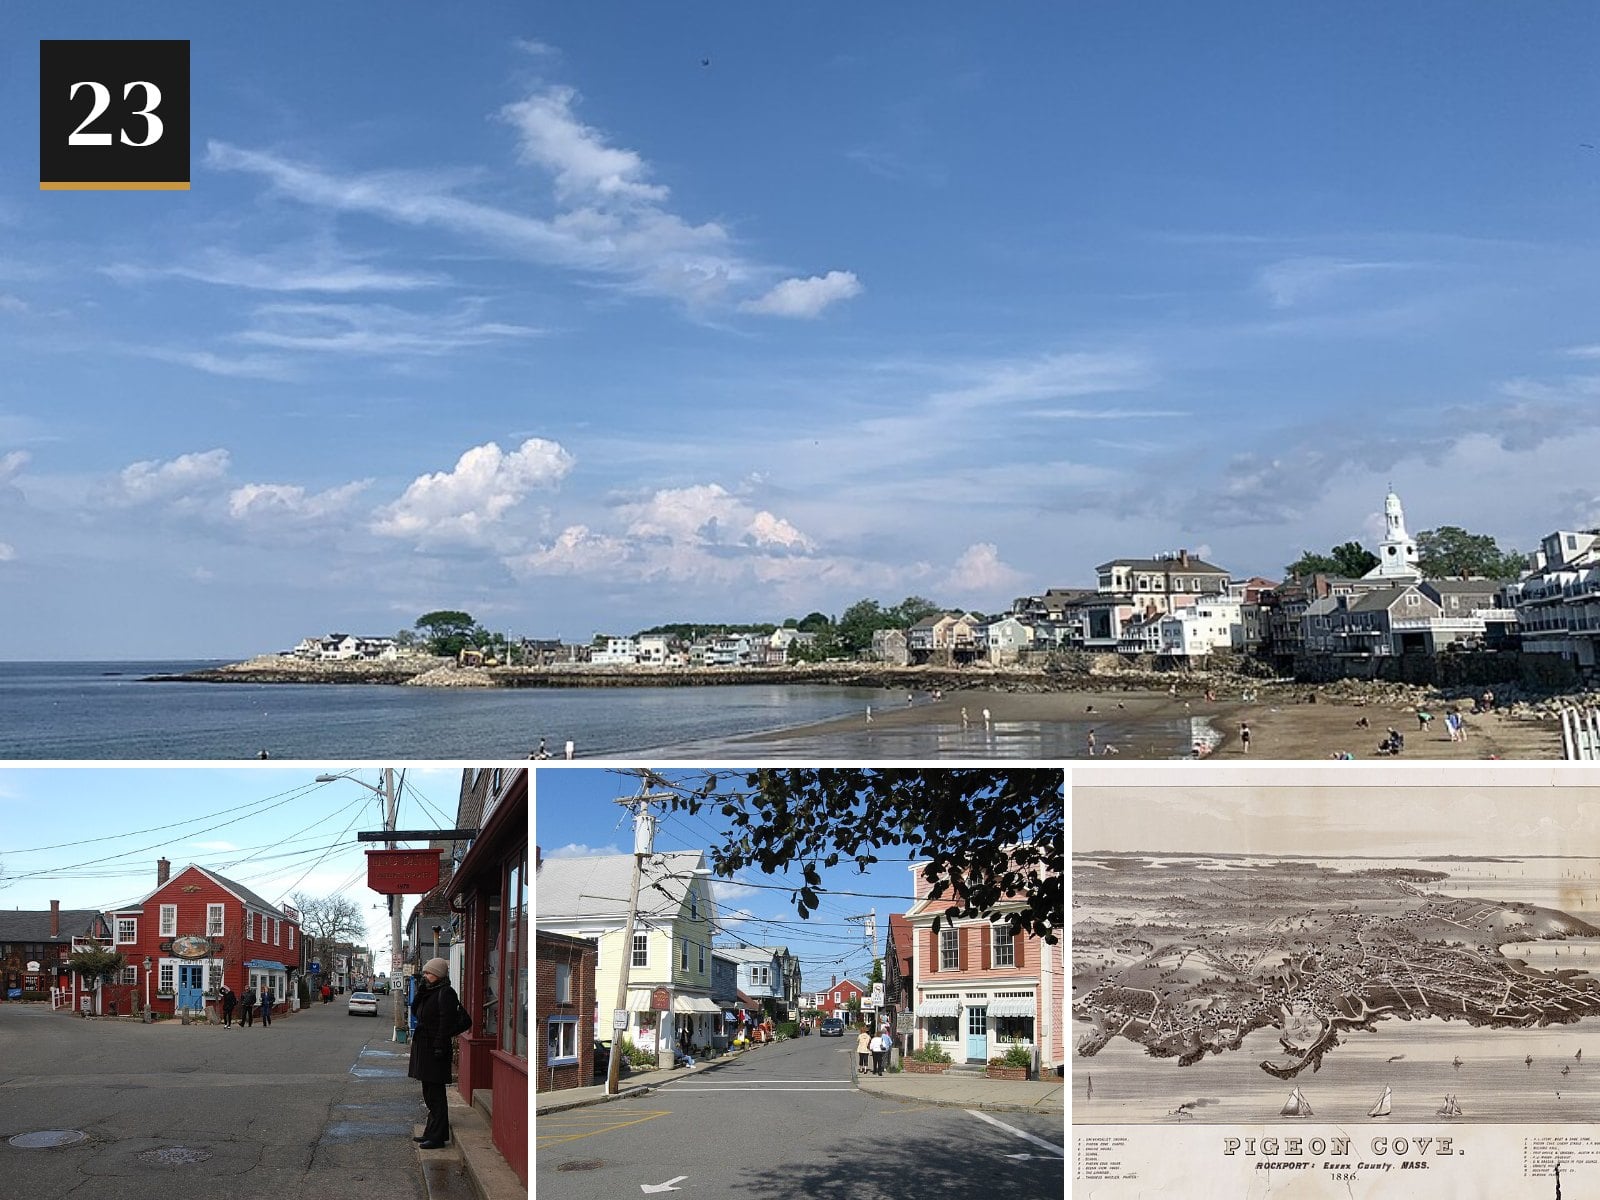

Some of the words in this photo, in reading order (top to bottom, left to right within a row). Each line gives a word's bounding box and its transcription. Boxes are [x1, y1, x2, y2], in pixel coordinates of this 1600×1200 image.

[393, 980, 402, 989] 10
[1223, 1137, 1351, 1156] PIGEON
[1370, 1137, 1466, 1156] COVE.
[1401, 1161, 1431, 1170] MASS.
